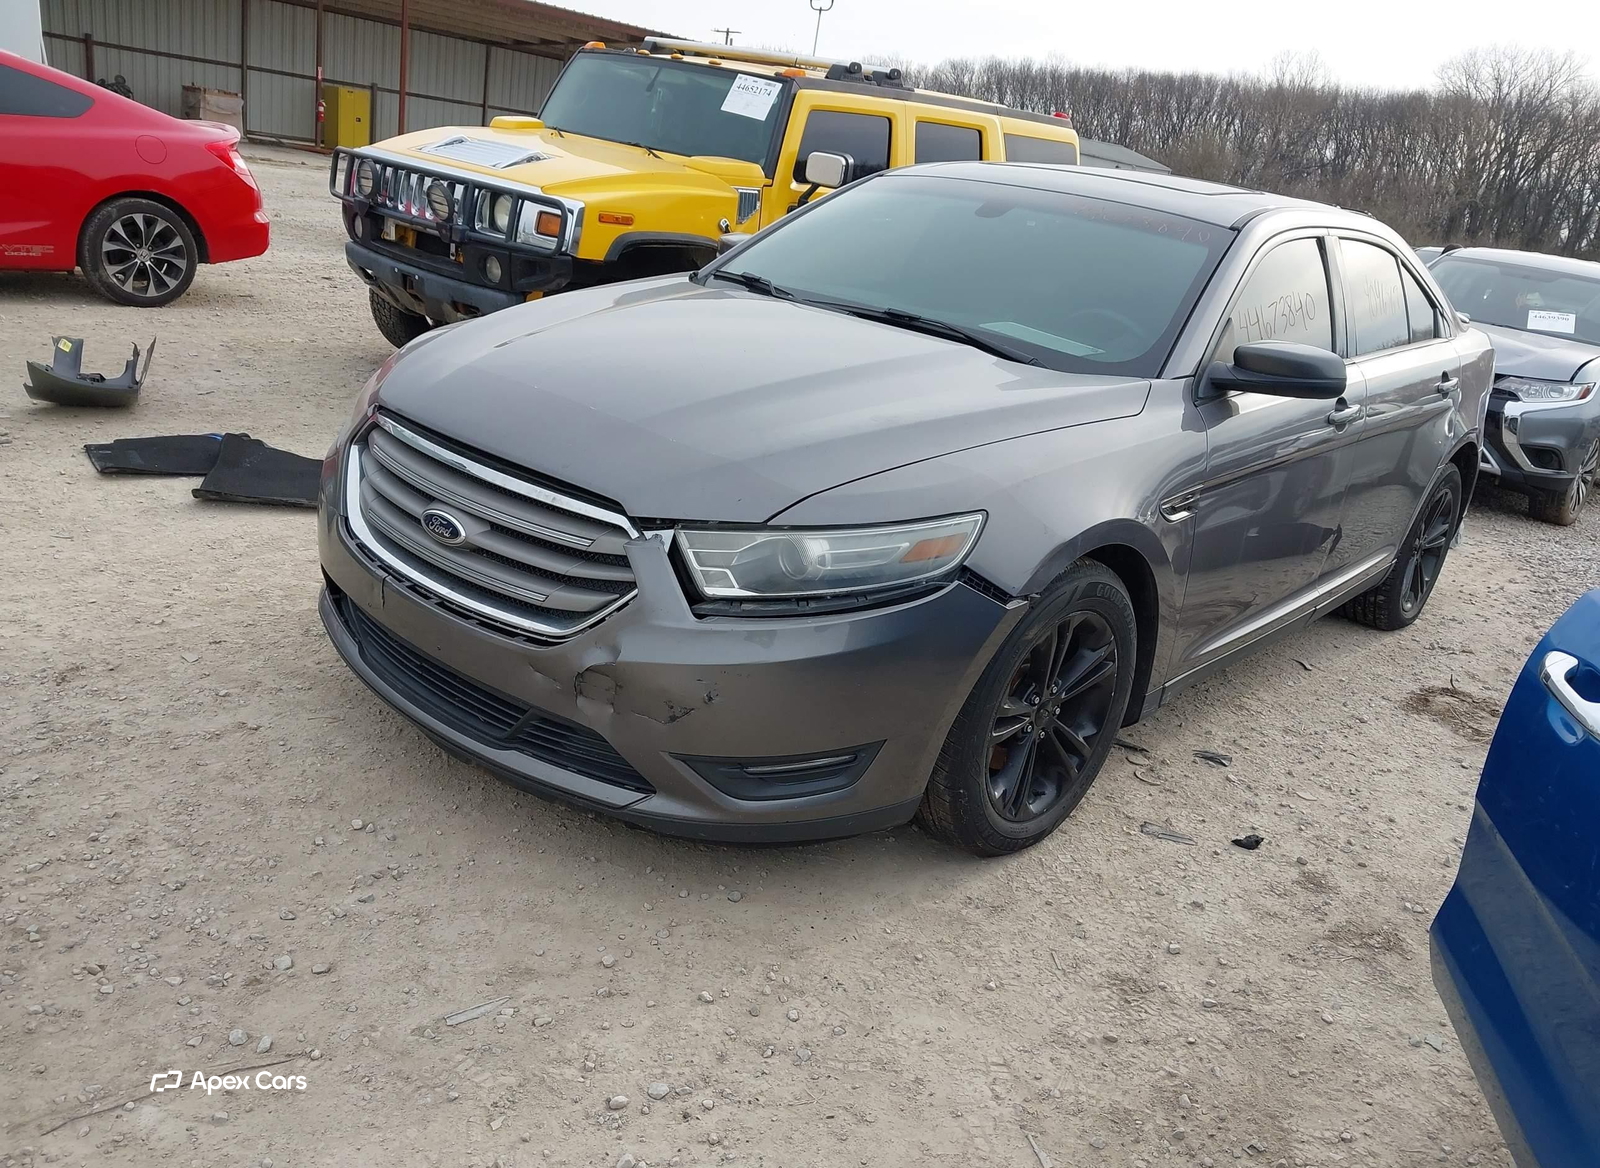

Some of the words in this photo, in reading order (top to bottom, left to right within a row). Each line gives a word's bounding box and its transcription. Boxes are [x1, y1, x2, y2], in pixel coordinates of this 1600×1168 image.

[736, 82, 773, 97] 44652174
[1238, 291, 1316, 342] 44673840
[428, 515, 453, 538] Ford
